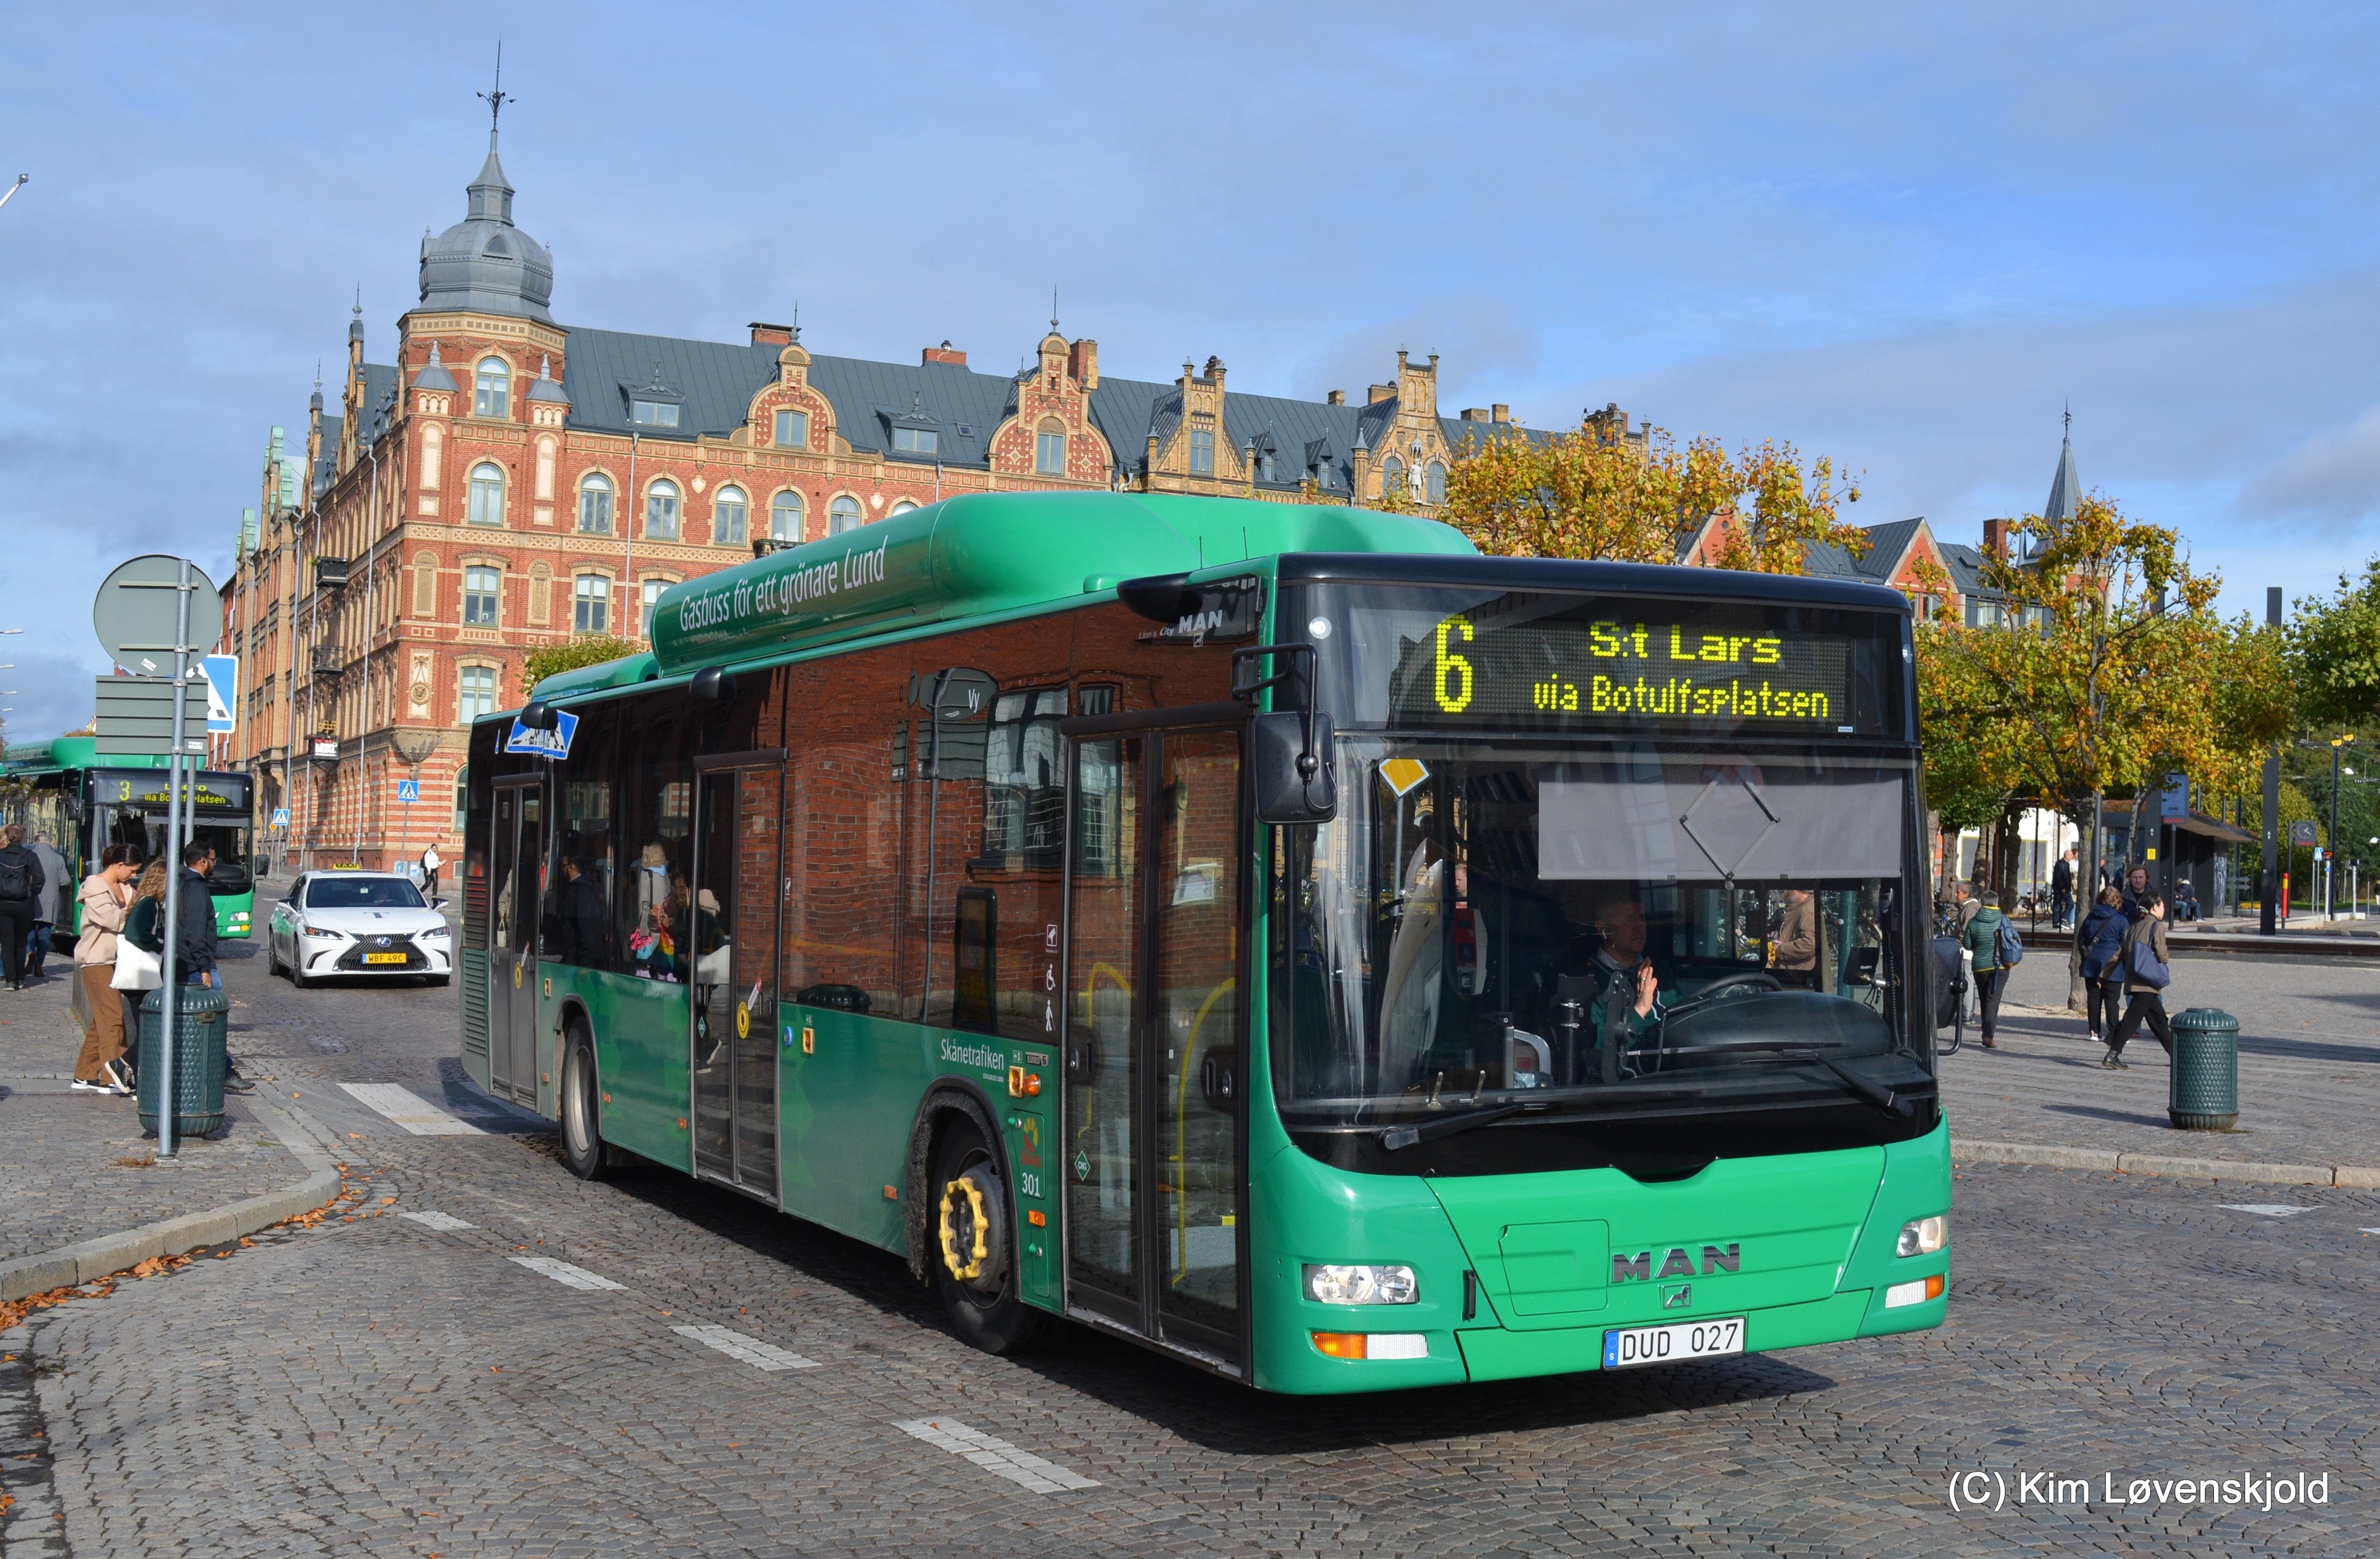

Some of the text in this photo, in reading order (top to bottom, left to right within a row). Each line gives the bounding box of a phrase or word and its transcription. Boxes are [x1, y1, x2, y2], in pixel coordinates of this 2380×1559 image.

[680, 534, 889, 632] Gasbuss för ett grönare Lund
[1159, 626, 1175, 636] City
[1178, 610, 1223, 633] MAN
[1670, 624, 1782, 664] Lars
[1435, 614, 1474, 713] 6
[968, 688, 980, 713] Vy
[1533, 674, 1829, 718] via Botulfsplatsen
[119, 780, 130, 801] 3
[144, 792, 157, 802] via
[387, 954, 403, 962] 49C
[941, 1038, 1004, 1071] Skånetrafiken
[1027, 1055, 1047, 1065] EURO 6
[1078, 1161, 1087, 1171] CNG
[1021, 1172, 1040, 1197] 301
[1611, 1242, 1740, 1283] MAN
[1623, 1322, 1739, 1361] DUD 027
[1609, 1353, 1615, 1361] S
